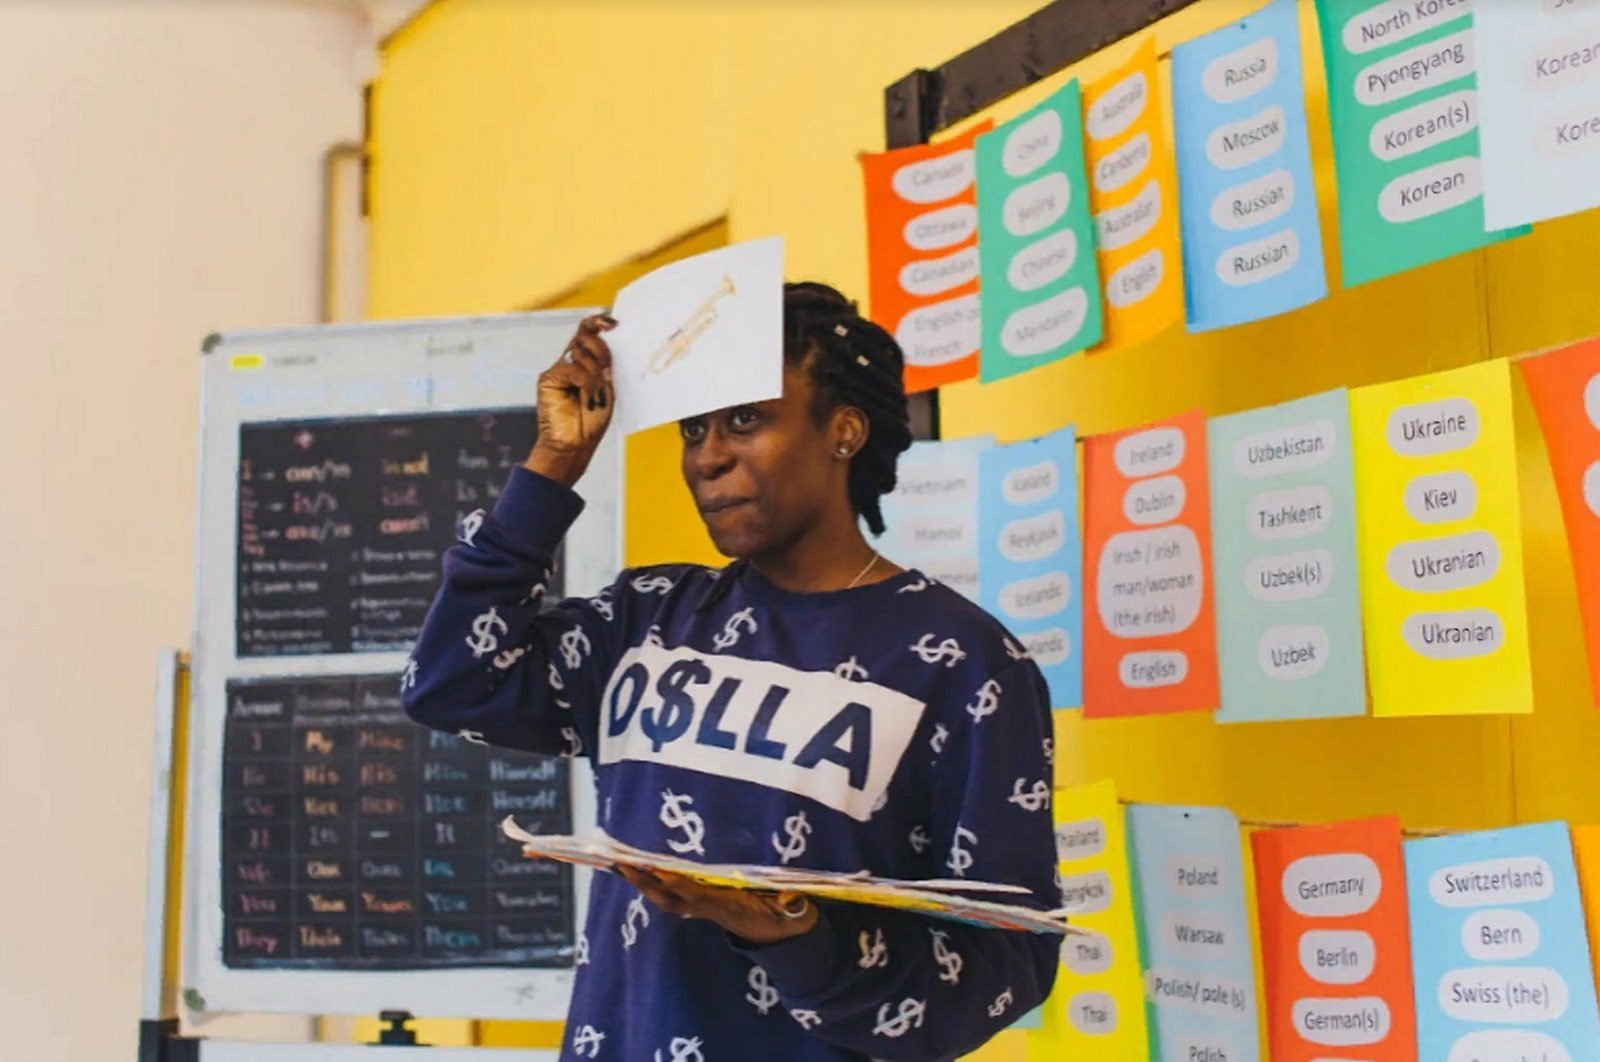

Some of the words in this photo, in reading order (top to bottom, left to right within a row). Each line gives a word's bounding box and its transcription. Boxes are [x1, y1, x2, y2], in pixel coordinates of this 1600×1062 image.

[1361, 10, 1411, 43] North
[1225, 56, 1267, 87] Russia
[1367, 43, 1465, 92] Pyongyang
[1223, 118, 1281, 153] Moscow
[1384, 100, 1471, 151] Korean(s)
[1232, 185, 1284, 219] Russian
[1400, 170, 1466, 207] Korean
[1234, 242, 1288, 275] Russian
[1122, 262, 1157, 294] English
[1402, 411, 1467, 442] Ukraine
[1129, 441, 1175, 467] Ireland
[1247, 434, 1325, 465] Uzbekistan
[1134, 491, 1175, 516] Dublin
[1423, 486, 1457, 512] Kiev
[1258, 504, 1322, 530] Tashkent
[1260, 560, 1322, 589] Uzbek(s)
[1412, 547, 1486, 579] Ukranian
[1113, 572, 1195, 597] man/woman
[1114, 606, 1141, 629] (the
[1422, 621, 1495, 645] Ukranian
[1271, 642, 1317, 668] Uzbek
[1131, 660, 1176, 683] English
[1178, 866, 1219, 886] Poland
[1298, 875, 1365, 900] Germany
[1445, 867, 1543, 895] Switzerland
[1174, 924, 1225, 945] Warsaw
[1481, 926, 1522, 946] Bern
[1316, 947, 1358, 968] Berlin
[1451, 982, 1501, 1004] Swiss
[1505, 982, 1549, 1010] (the)
[1304, 1008, 1380, 1031] German(s)
